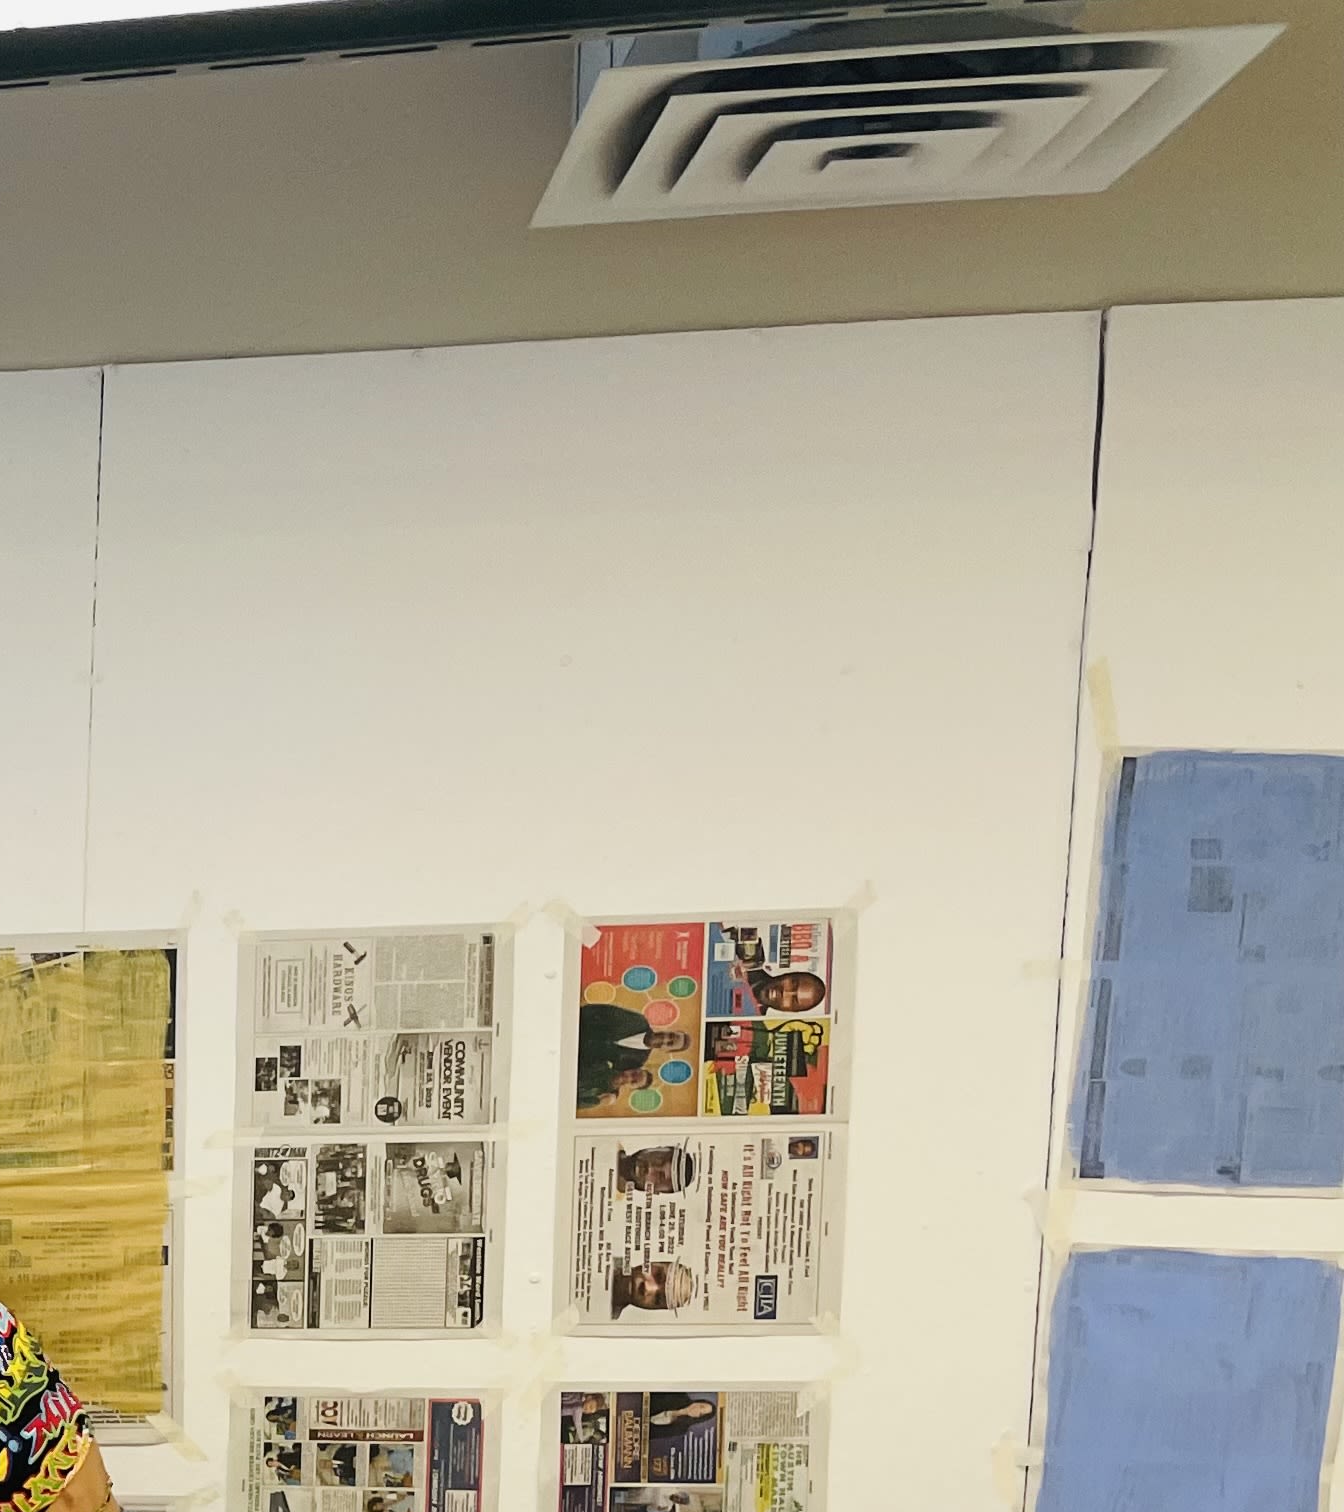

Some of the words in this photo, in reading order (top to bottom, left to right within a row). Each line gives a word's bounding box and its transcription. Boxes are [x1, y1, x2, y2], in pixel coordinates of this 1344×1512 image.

[332, 954, 343, 1016] HARDWARE
[443, 1039, 453, 1084] VENDOR
[453, 1041, 466, 1119] COMMUNITY
[773, 1032, 788, 1106] JUNETEENTH
[442, 1087, 452, 1120] EVENT
[743, 1164, 754, 1178] All
[739, 1247, 751, 1267] Feel
